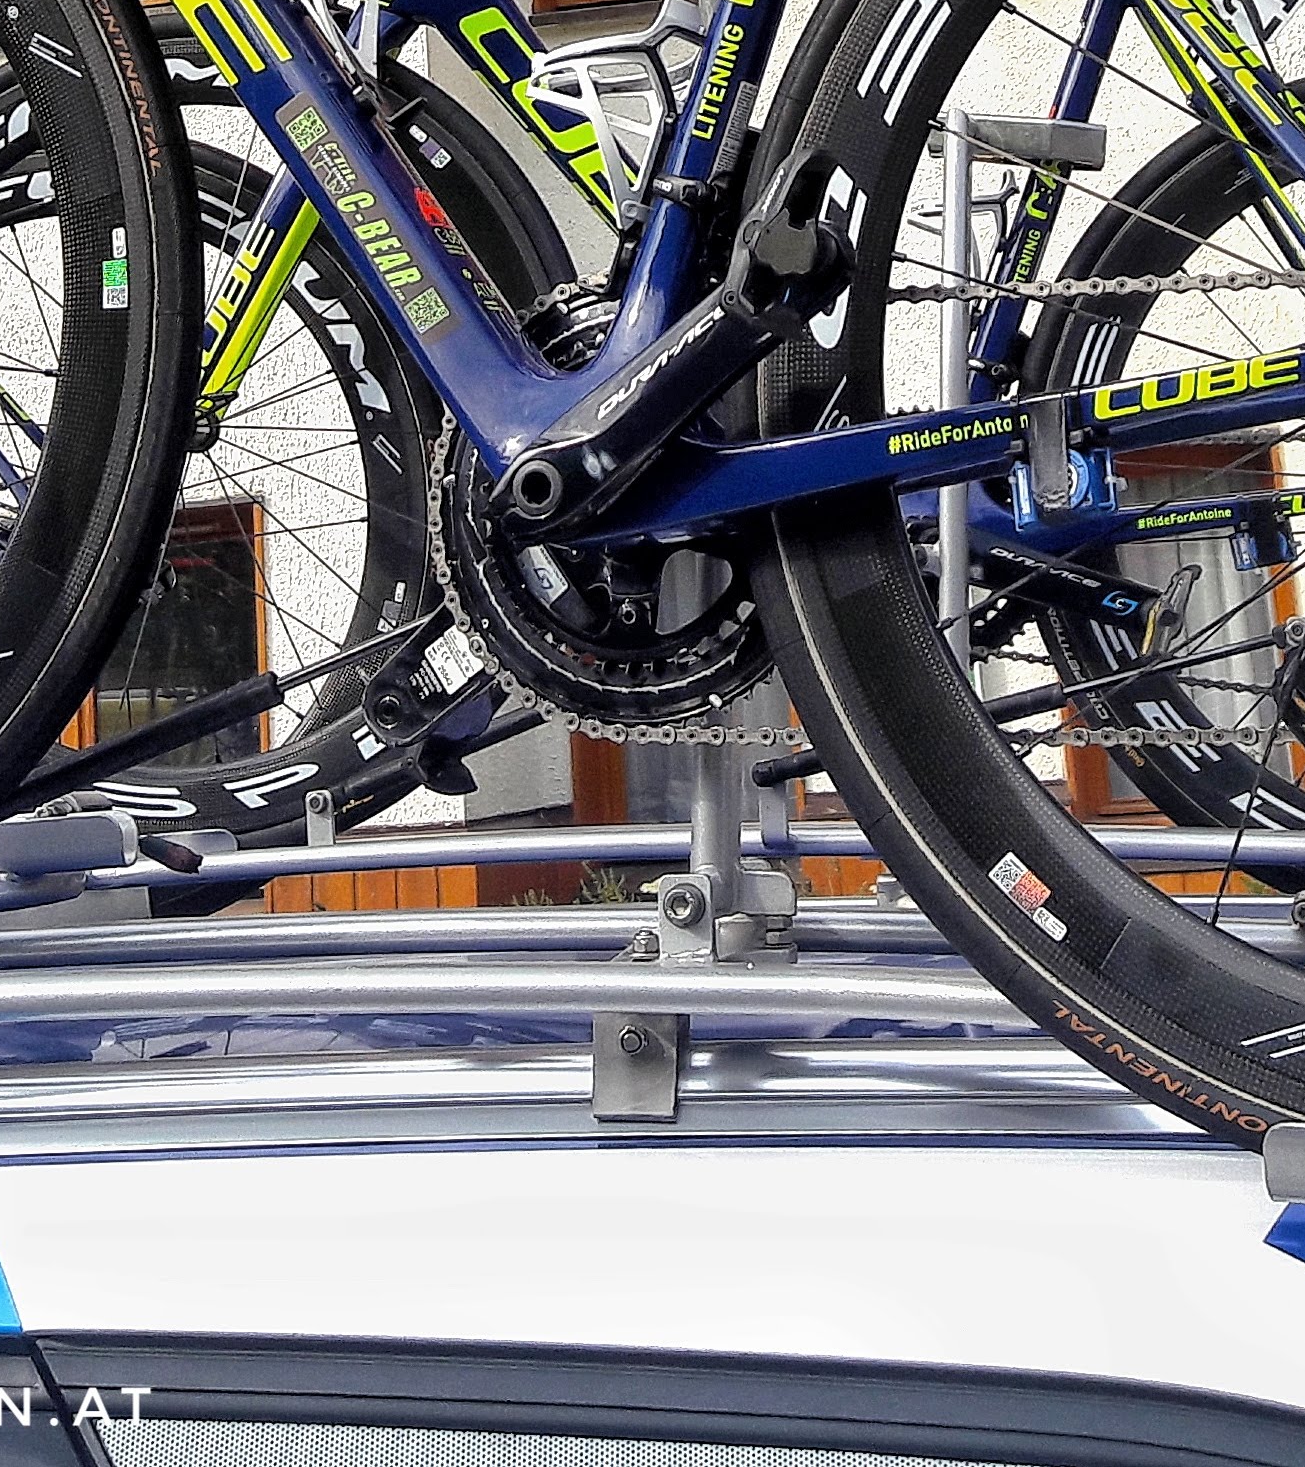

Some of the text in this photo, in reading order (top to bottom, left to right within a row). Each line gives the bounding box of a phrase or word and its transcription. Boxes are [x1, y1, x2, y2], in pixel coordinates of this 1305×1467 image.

[692, 23, 744, 140] LITENING
[336, 190, 423, 288] C-BEAR
[1012, 229, 1041, 283] TENING
[202, 222, 276, 367] UBE
[1094, 350, 1299, 420] CUBE
[1138, 505, 1233, 530] #RideForAntoine
[1052, 1000, 1269, 1133] ONTINENTAL
